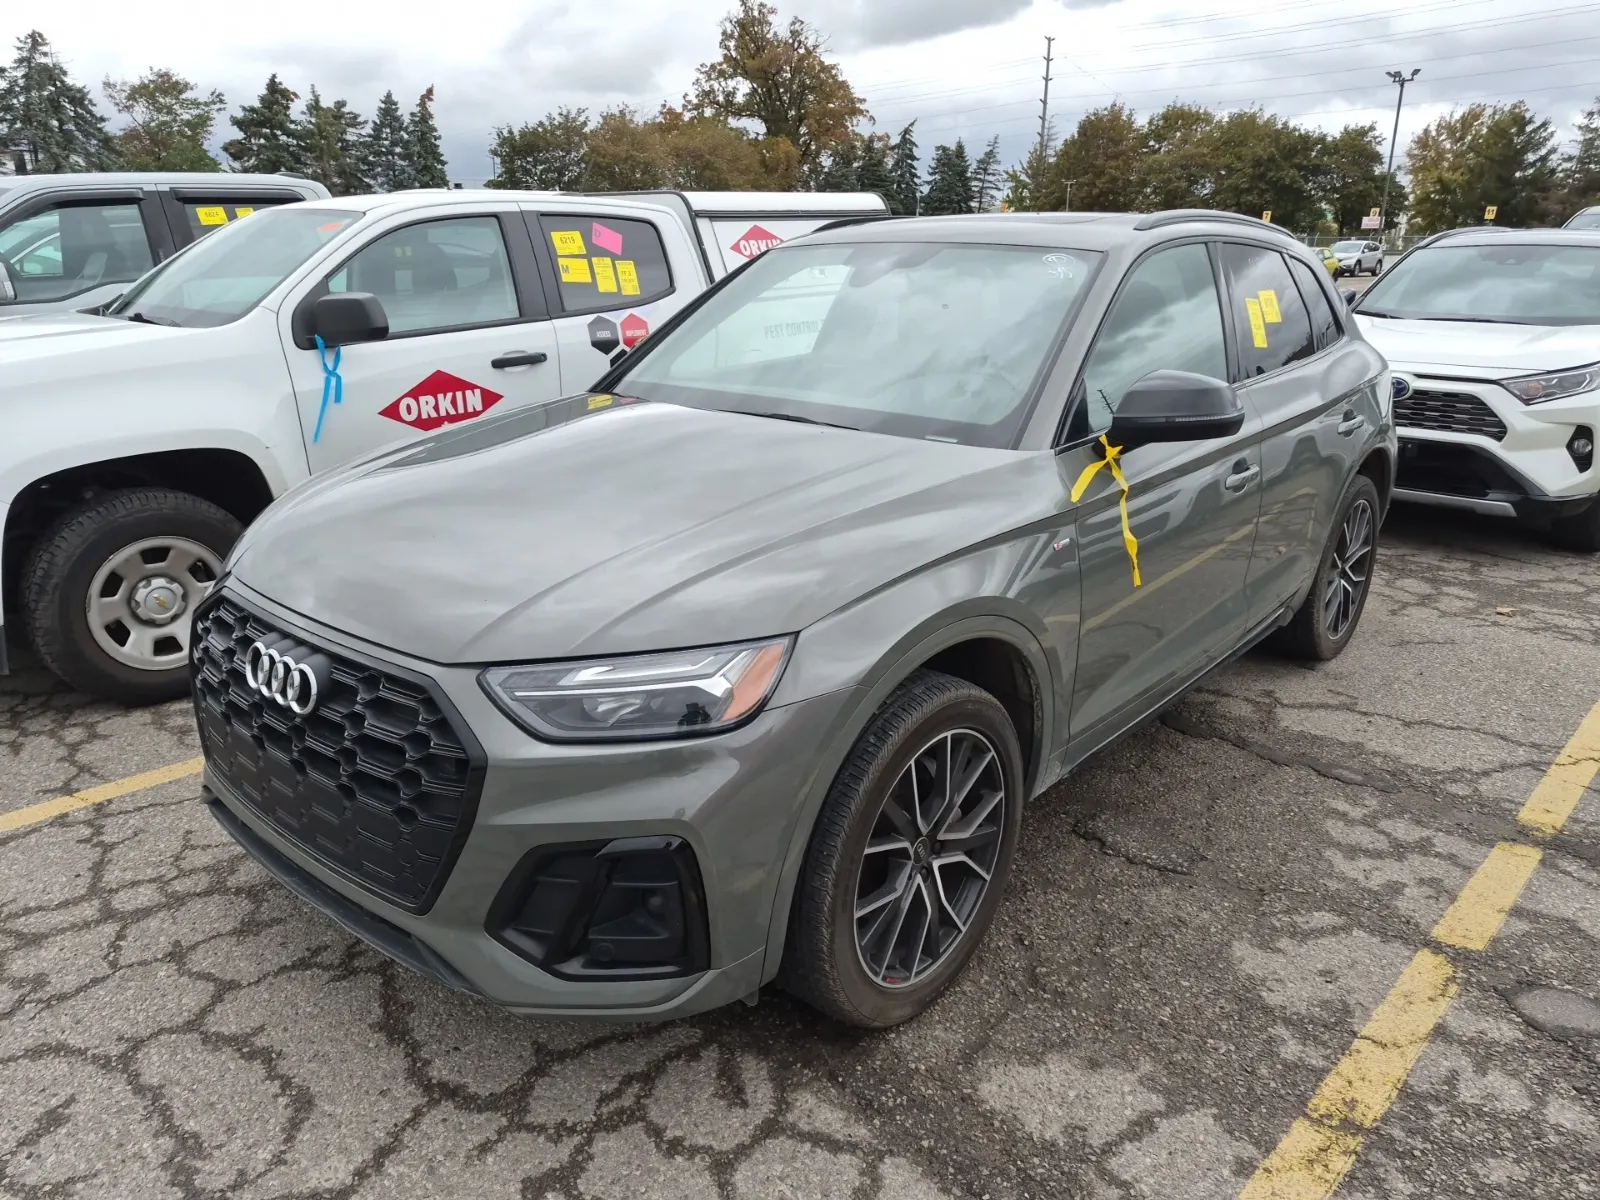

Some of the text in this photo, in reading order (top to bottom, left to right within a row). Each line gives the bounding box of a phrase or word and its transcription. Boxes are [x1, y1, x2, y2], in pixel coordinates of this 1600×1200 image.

[560, 264, 570, 274] M
[764, 324, 784, 339] PEST
[786, 320, 820, 337] CONTROL
[399, 389, 483, 422] ORKIN
